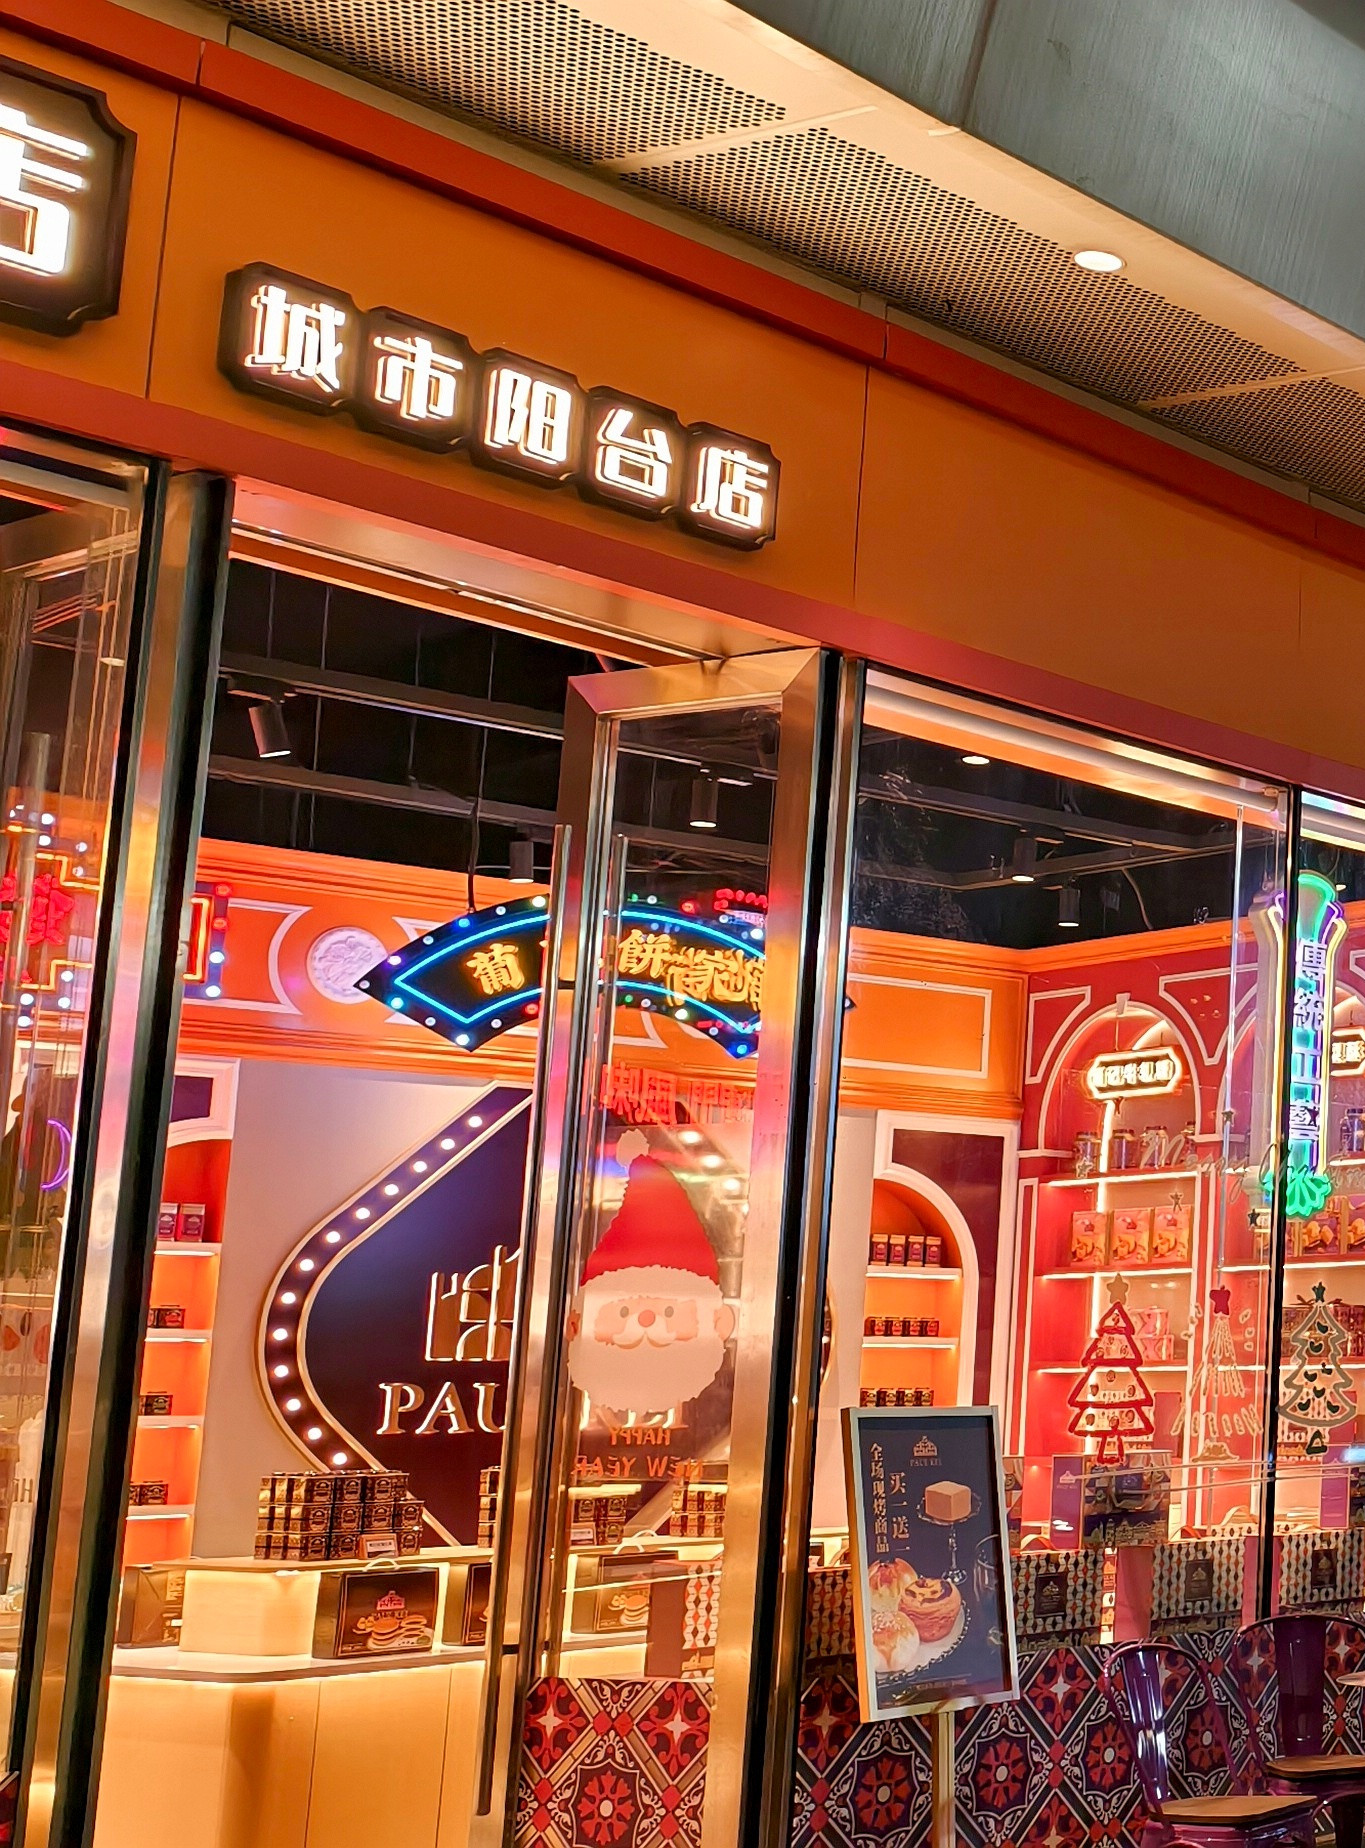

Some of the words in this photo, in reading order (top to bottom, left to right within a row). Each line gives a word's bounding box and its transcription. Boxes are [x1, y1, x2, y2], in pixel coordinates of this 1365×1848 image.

[243, 283, 769, 531] 城市阳台店
[375, 1381, 507, 1435] PAU
[889, 1471, 910, 1552] 买一送一
